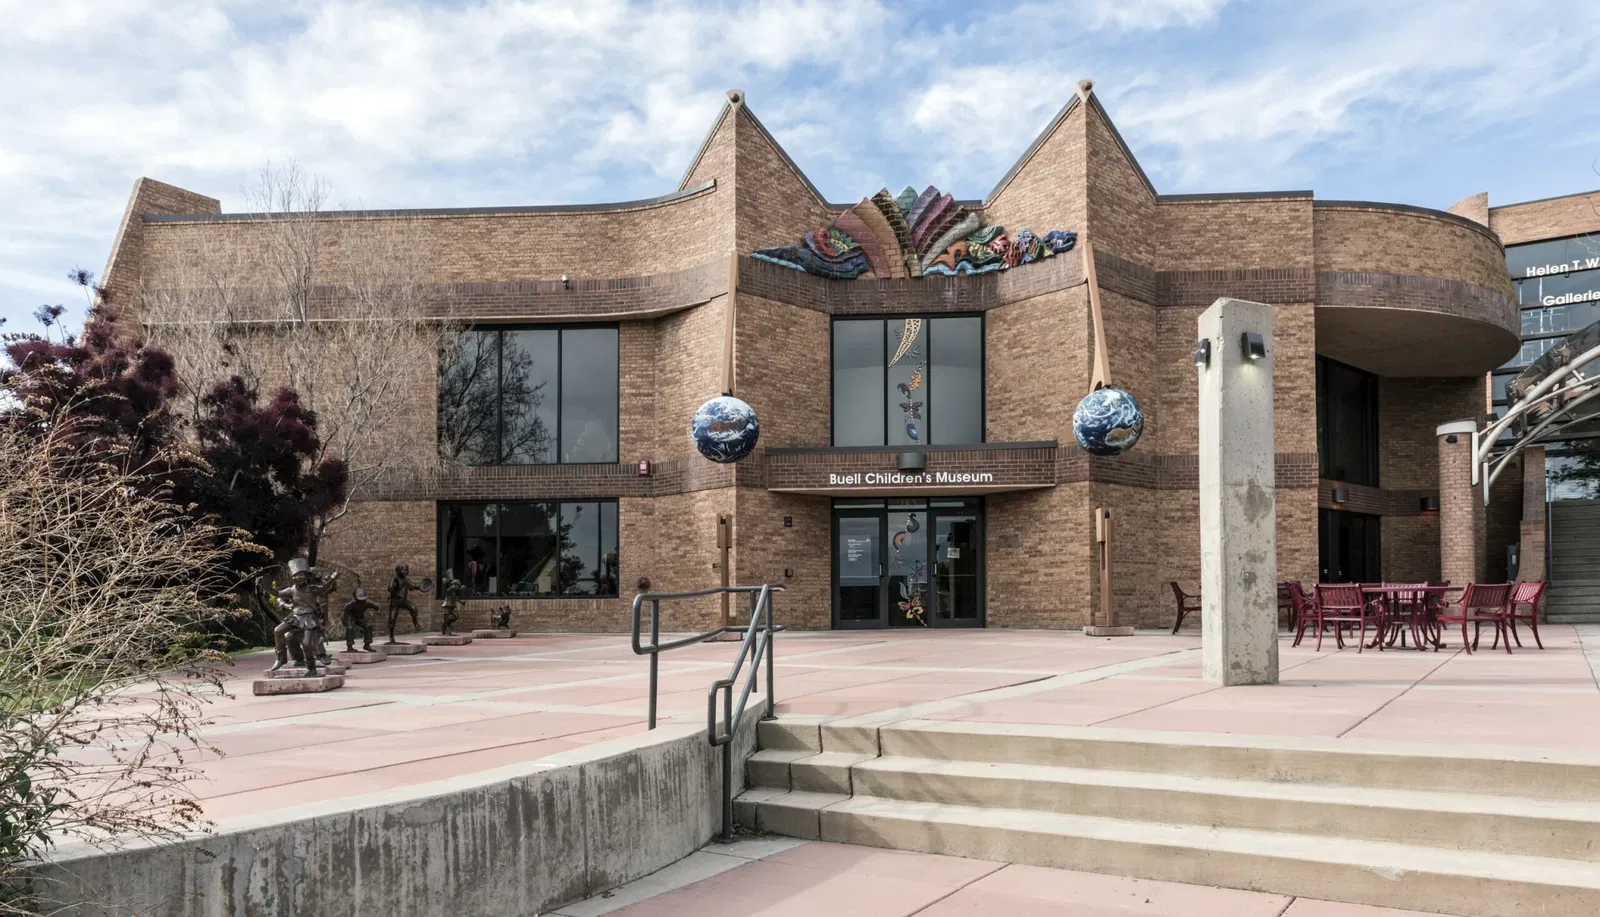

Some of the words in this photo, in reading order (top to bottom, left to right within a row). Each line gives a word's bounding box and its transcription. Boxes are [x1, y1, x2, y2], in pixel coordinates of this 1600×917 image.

[1526, 263, 1569, 277] Helen
[1572, 260, 1583, 271] T.
[829, 473, 861, 485] Buell
[865, 472, 932, 484] Children's
[936, 471, 993, 483] Museum
